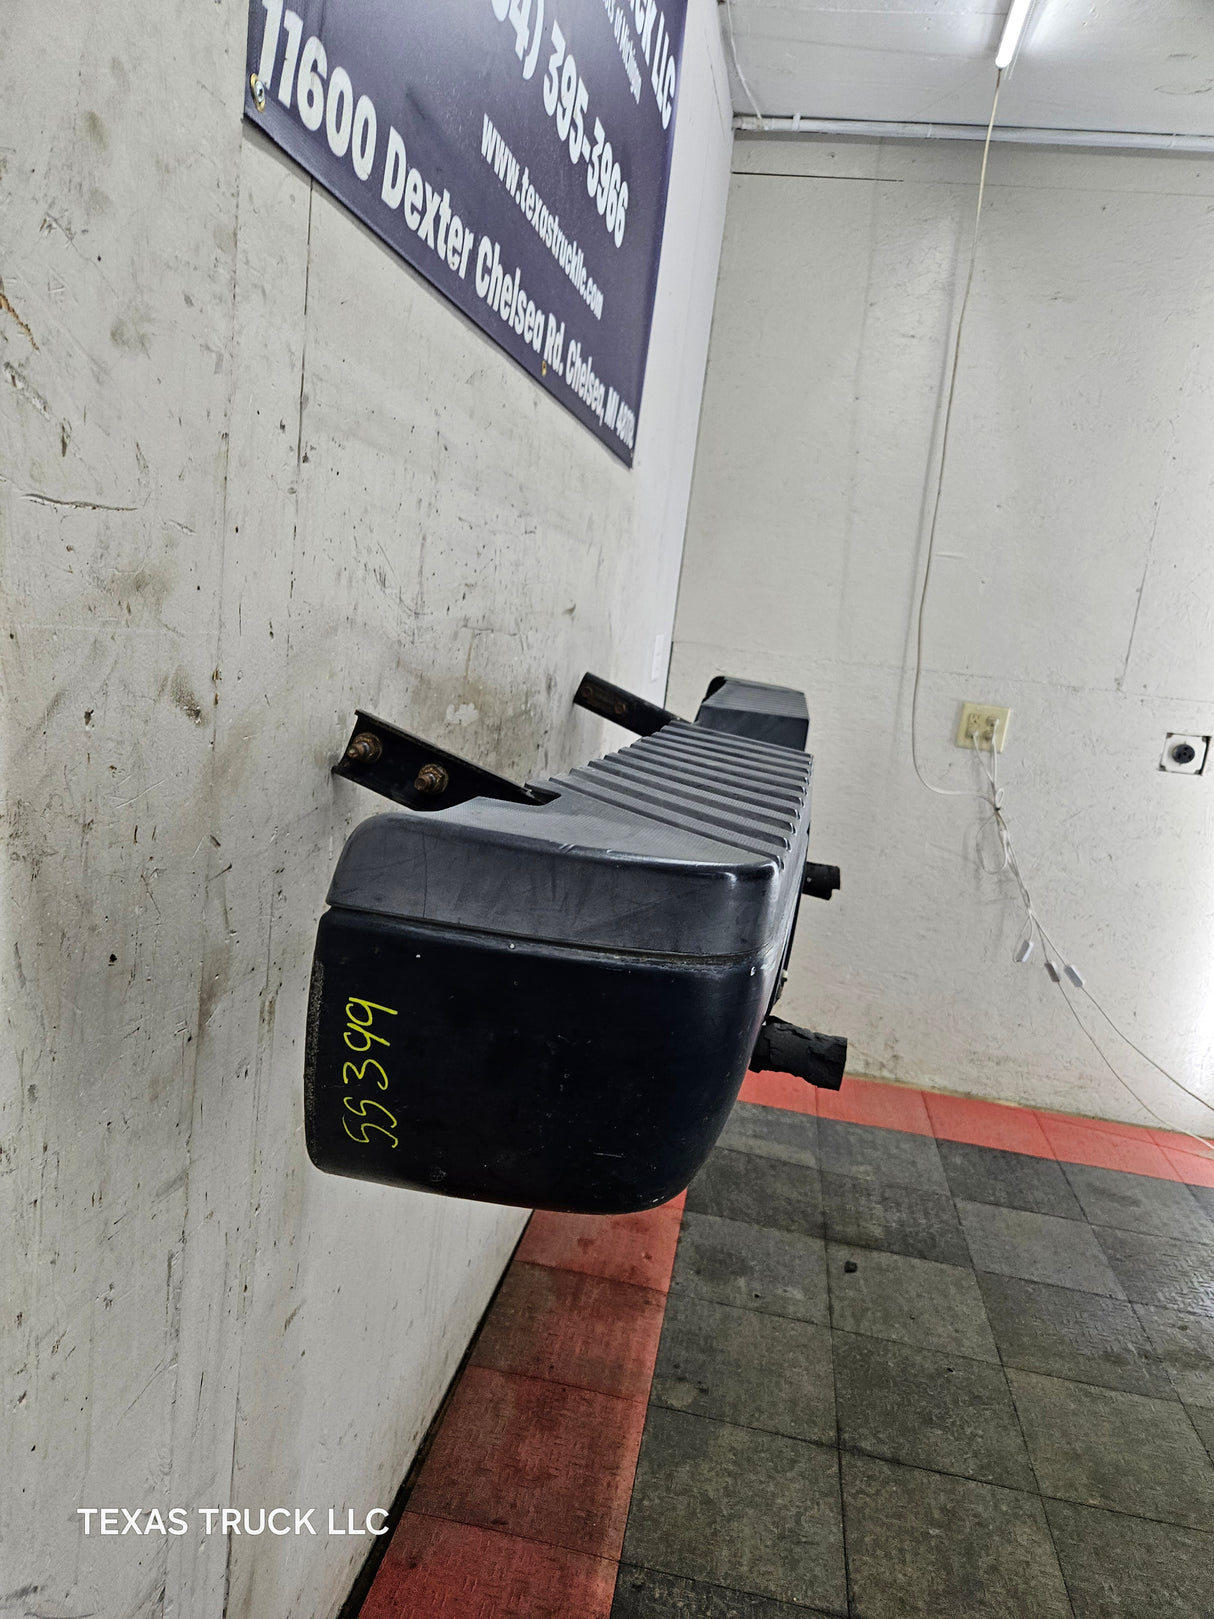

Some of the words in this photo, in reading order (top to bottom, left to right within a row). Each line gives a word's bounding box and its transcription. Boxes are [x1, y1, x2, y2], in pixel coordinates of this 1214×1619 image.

[491, 0, 544, 80] 4)
[543, 19, 629, 248] 395-3966
[651, 11, 676, 129] LLC
[257, 0, 377, 181] 11600
[381, 126, 474, 279] Dexter
[475, 236, 545, 353] Chelsea
[544, 313, 565, 376] Rd.
[566, 340, 605, 426] Chelsea,
[481, 113, 604, 320] www.texastruckllc.com
